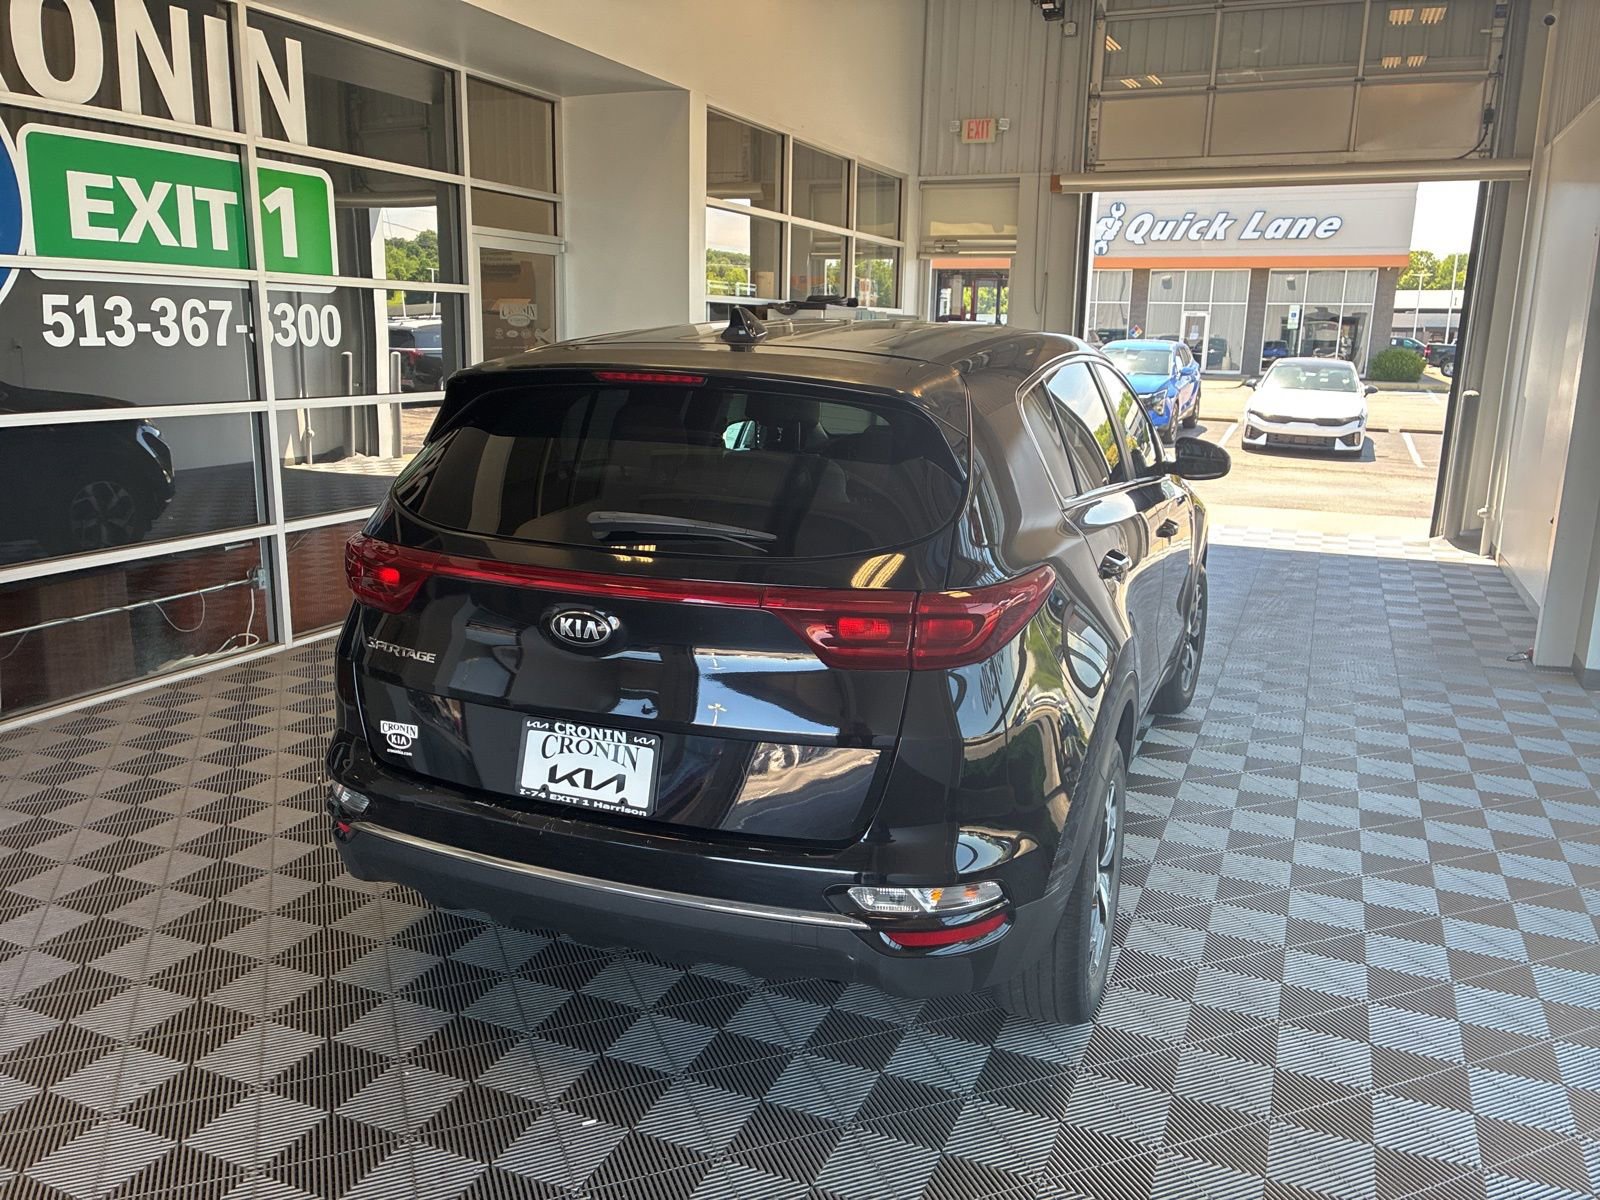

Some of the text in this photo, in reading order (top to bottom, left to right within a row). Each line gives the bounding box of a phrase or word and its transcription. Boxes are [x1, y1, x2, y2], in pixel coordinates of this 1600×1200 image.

[0, 0, 308, 146] ONIN
[967, 119, 992, 139] EXIT
[66, 170, 299, 258] EXIT 1
[1124, 210, 1343, 245] Quick Lane
[559, 617, 600, 639] KIA
[367, 636, 437, 664] SPORTAGE
[382, 722, 416, 737] CRONIN
[391, 734, 407, 746] KIA
[554, 722, 627, 744] CRONIN
[541, 734, 640, 773] CRONIN
[548, 763, 626, 794] KIA
[520, 788, 647, 817] I-74 EXIT 1 Harrison
